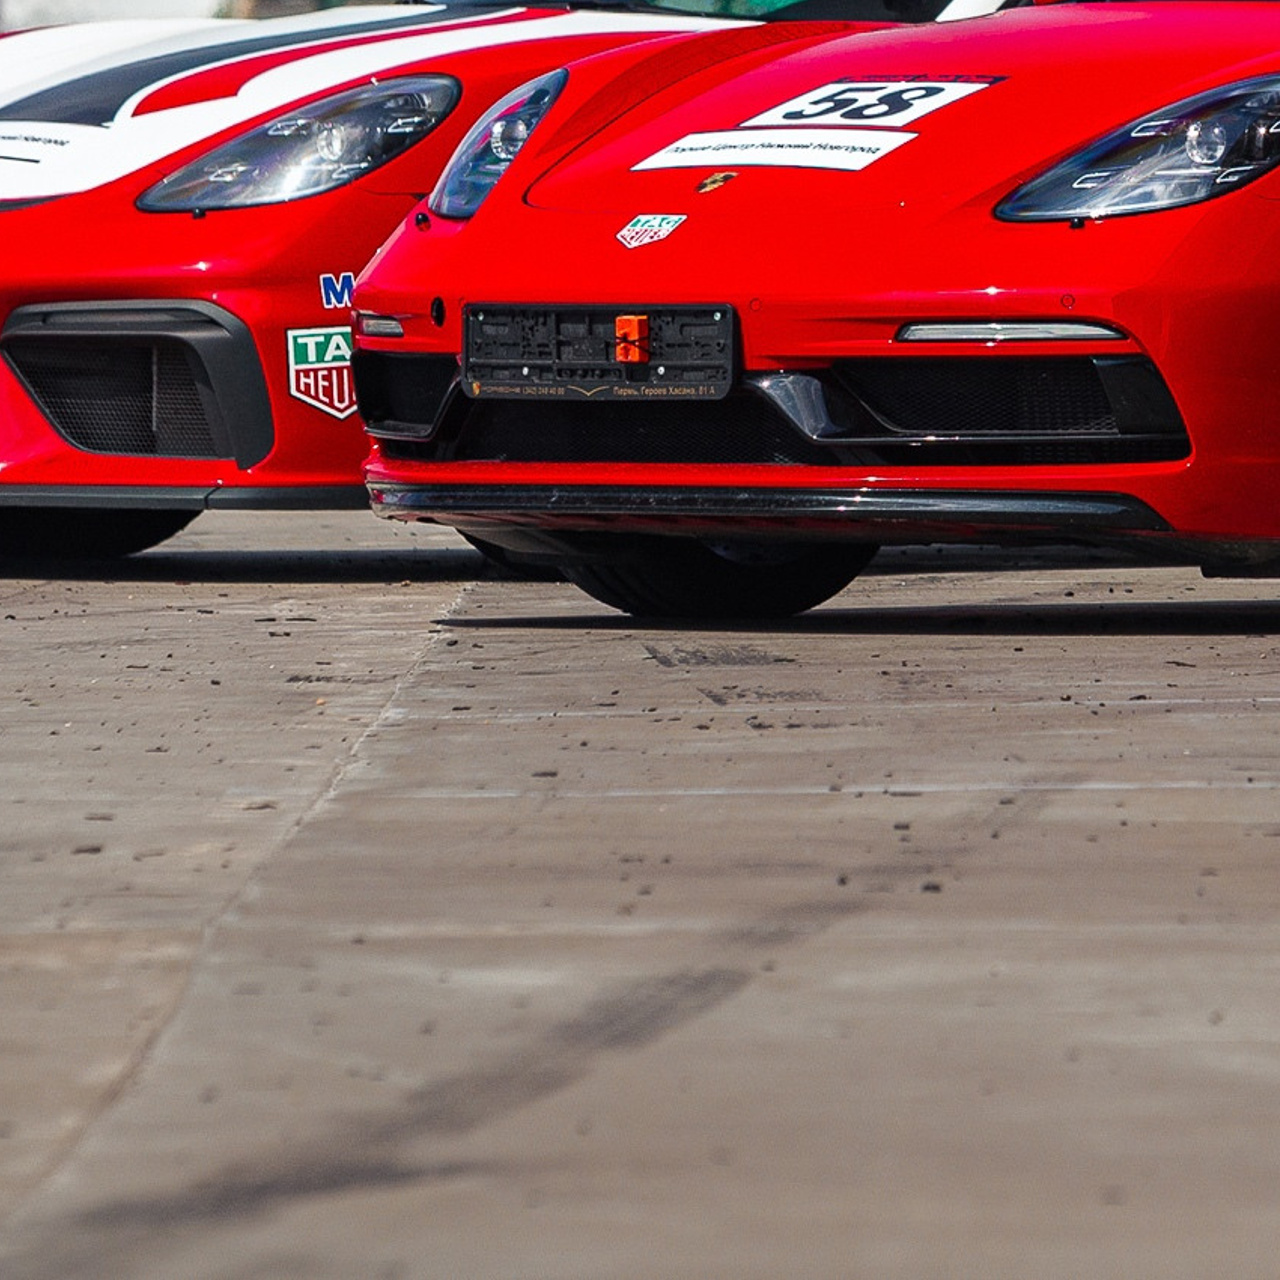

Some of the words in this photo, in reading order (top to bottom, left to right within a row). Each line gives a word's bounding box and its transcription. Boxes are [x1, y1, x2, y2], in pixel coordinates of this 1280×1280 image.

[782, 86, 946, 120] 58
[320, 273, 354, 308] M
[297, 334, 352, 362] TA
[300, 369, 356, 410] HEU
